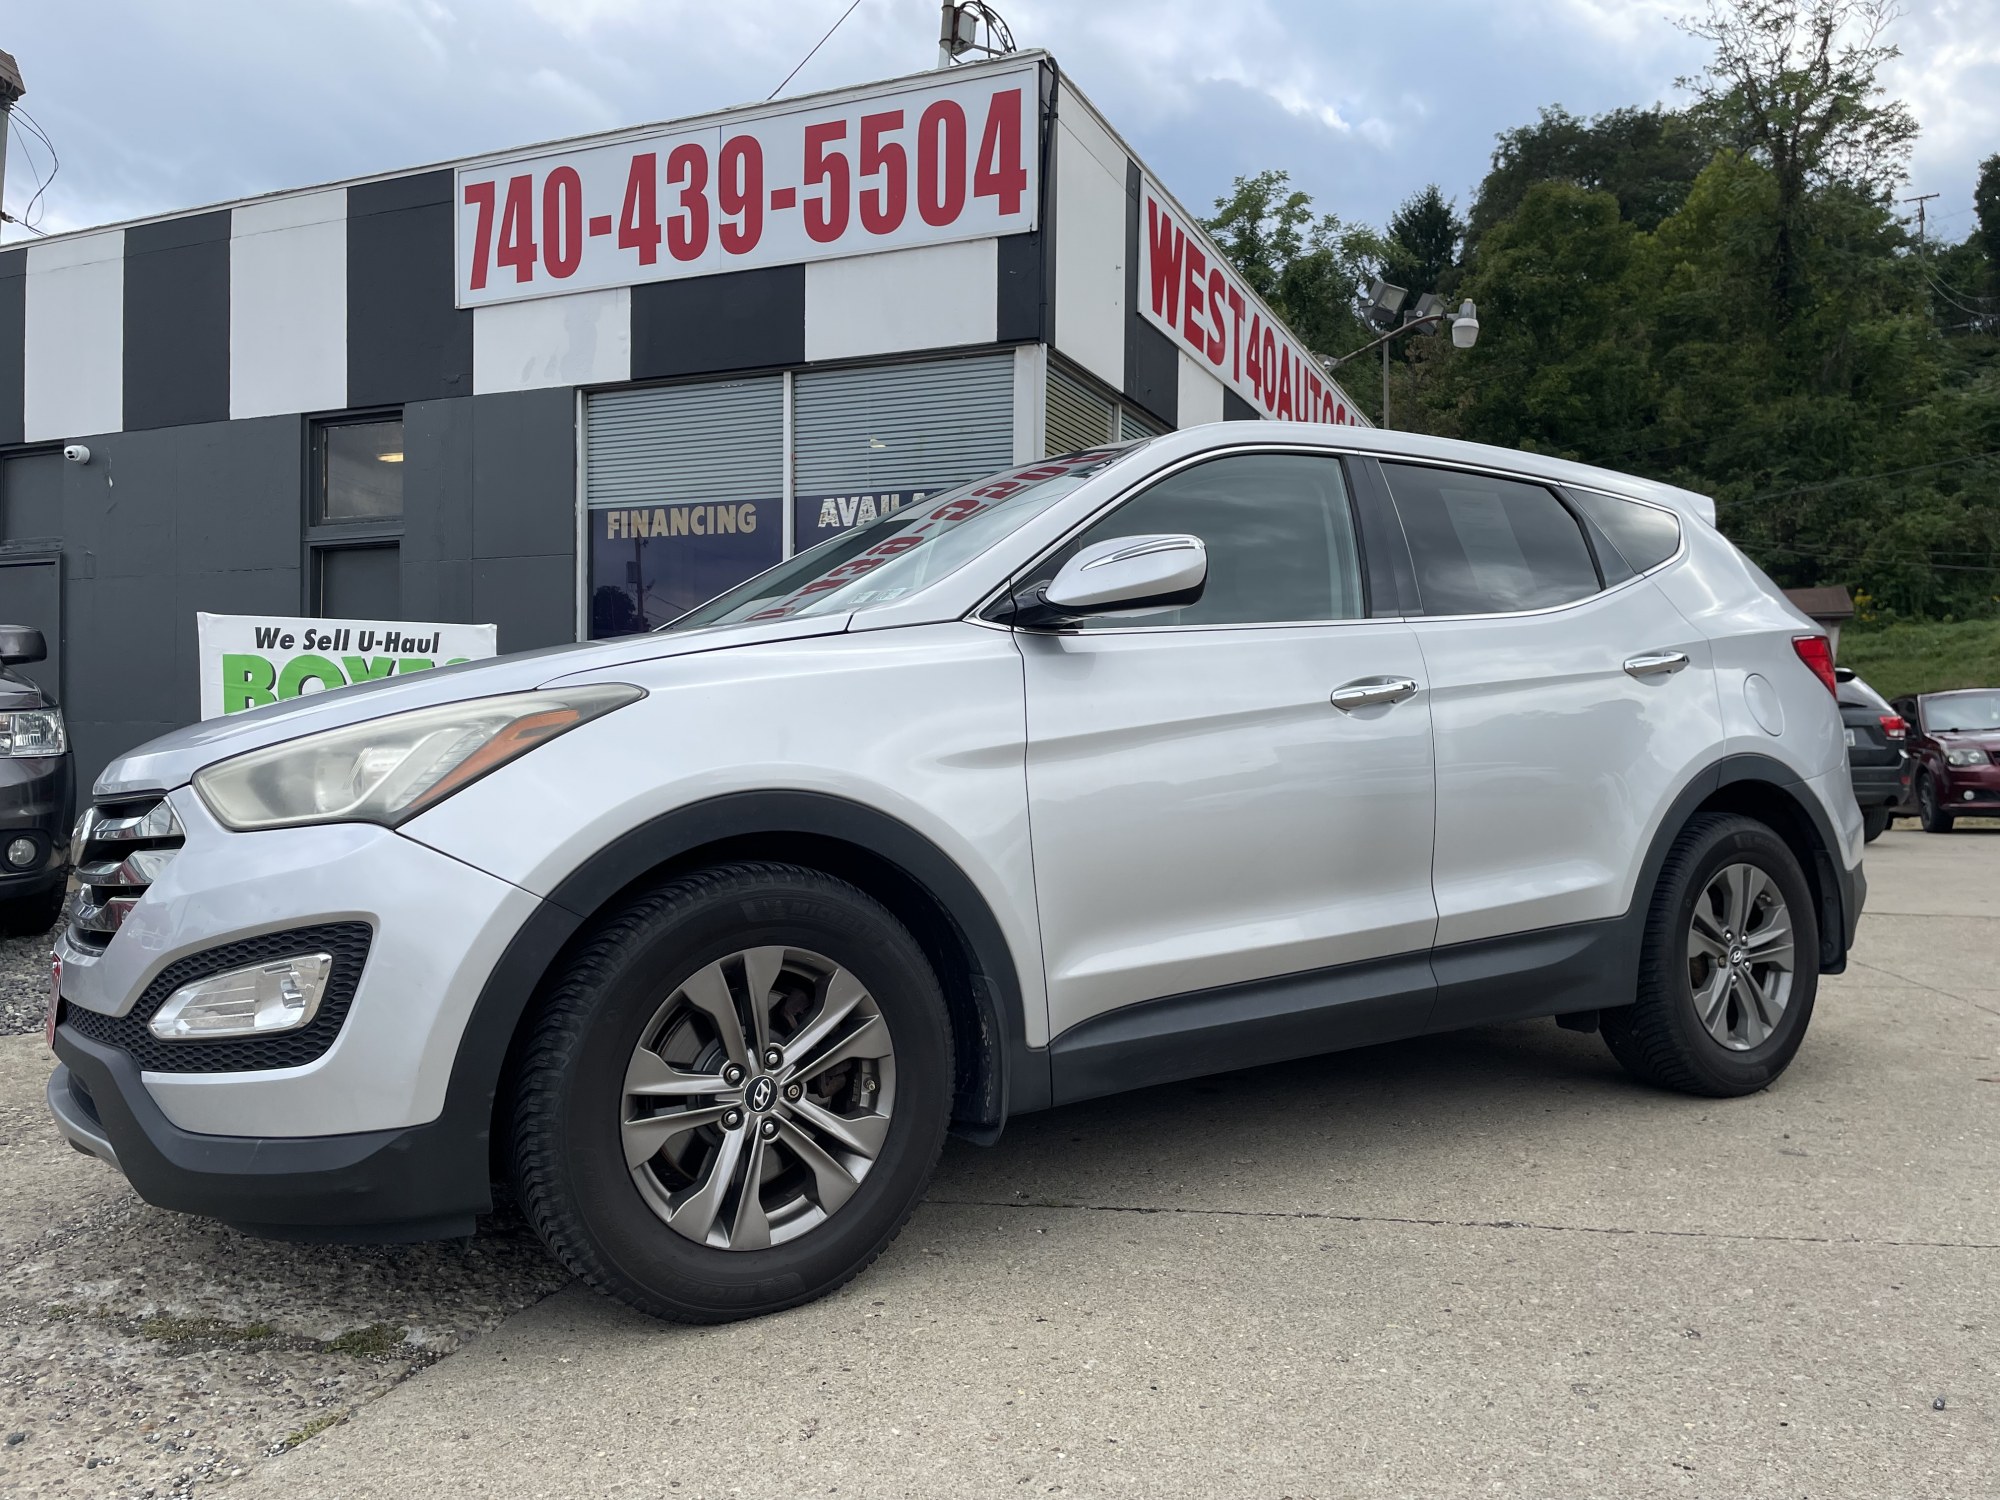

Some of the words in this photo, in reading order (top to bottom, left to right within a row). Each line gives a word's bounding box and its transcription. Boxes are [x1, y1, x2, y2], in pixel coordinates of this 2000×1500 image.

[464, 88, 1027, 290] 740-439-5504
[607, 503, 757, 539] FINANCING
[255, 627, 295, 650] We
[302, 629, 350, 651] Sell
[358, 631, 440, 653] U-Haul
